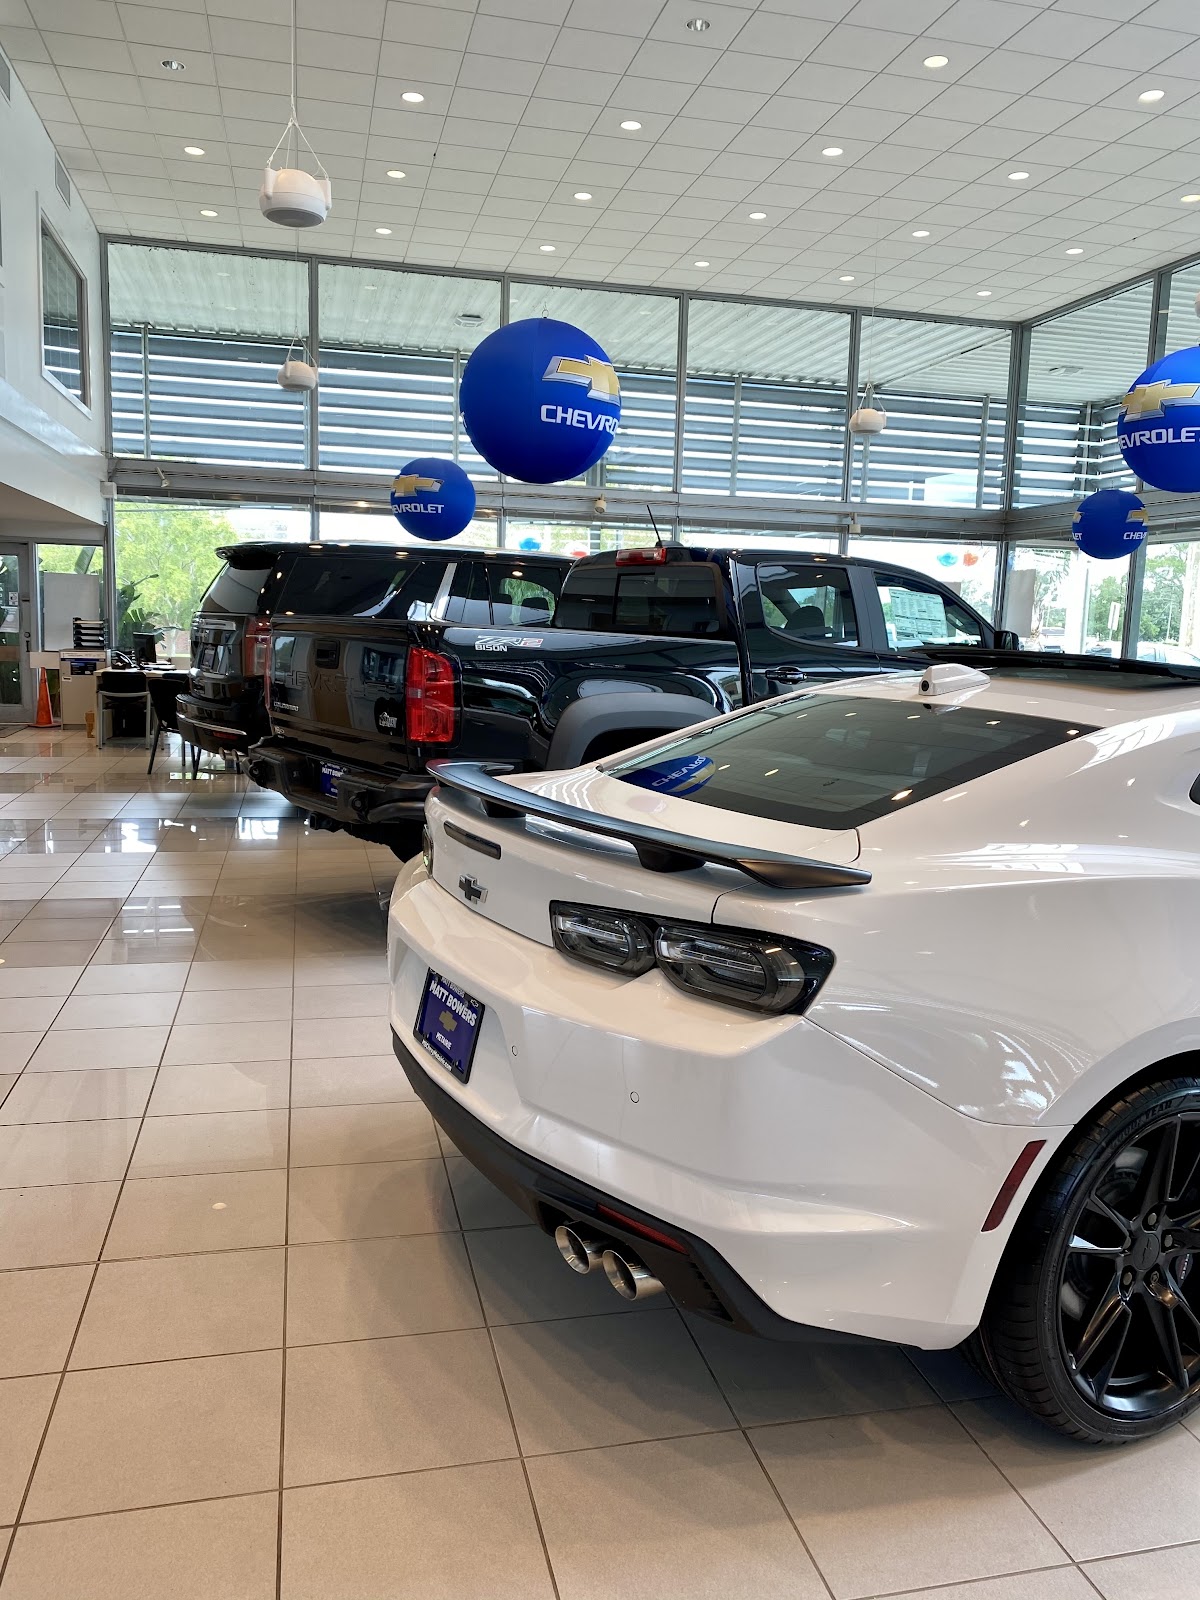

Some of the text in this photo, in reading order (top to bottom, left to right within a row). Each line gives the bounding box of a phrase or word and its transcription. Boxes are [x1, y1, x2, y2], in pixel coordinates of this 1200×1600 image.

[475, 644, 508, 652] BISON
[429, 980, 478, 1027] MATT BOWERS
